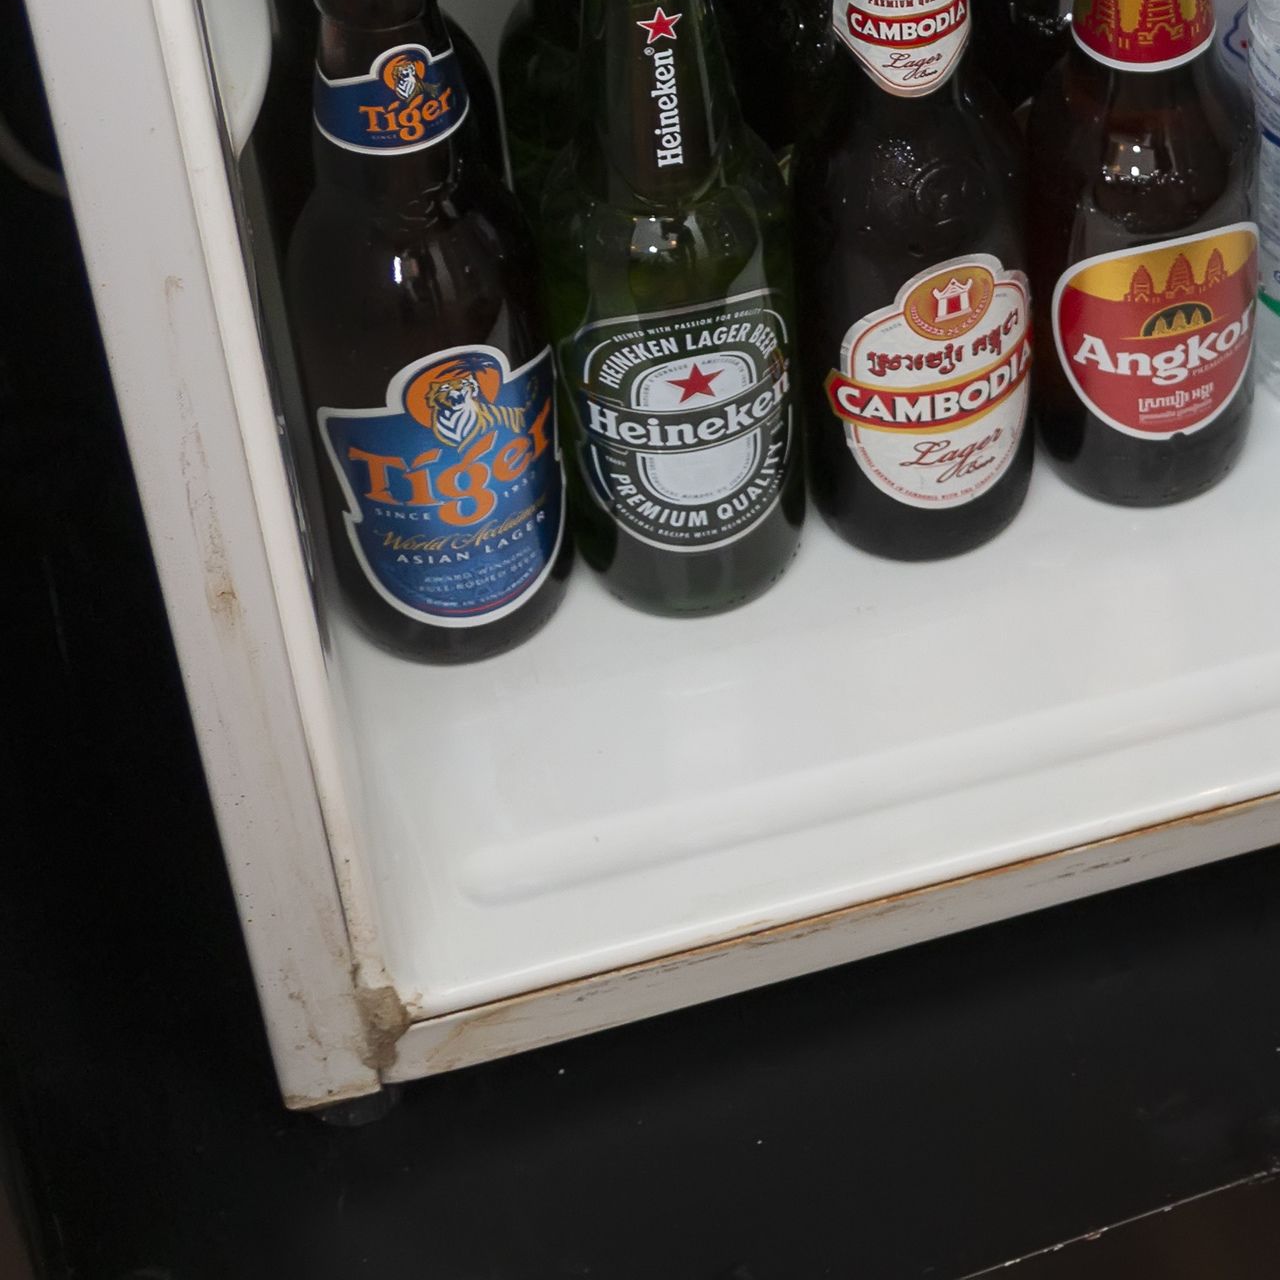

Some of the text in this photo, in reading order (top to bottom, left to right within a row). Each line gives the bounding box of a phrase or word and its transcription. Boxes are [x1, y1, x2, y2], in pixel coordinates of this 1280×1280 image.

[850, 0, 965, 40] CAMBODIA
[882, 52, 943, 81] Lager
[359, 87, 452, 141] Tiger
[653, 48, 684, 170] Heineken
[675, 318, 712, 330] PASSION
[1073, 300, 1254, 386] Angkor
[599, 323, 778, 388] HEINEKEN LAGER BEER
[837, 339, 1032, 423] CAMBODIA
[587, 372, 790, 446] Heineken
[349, 401, 550, 526] Tiger
[611, 441, 783, 526] PREMIUM QUALITY
[899, 427, 1003, 483] Lager
[374, 508, 430, 520] SINCE
[397, 511, 545, 564] ASIAN LAGER
